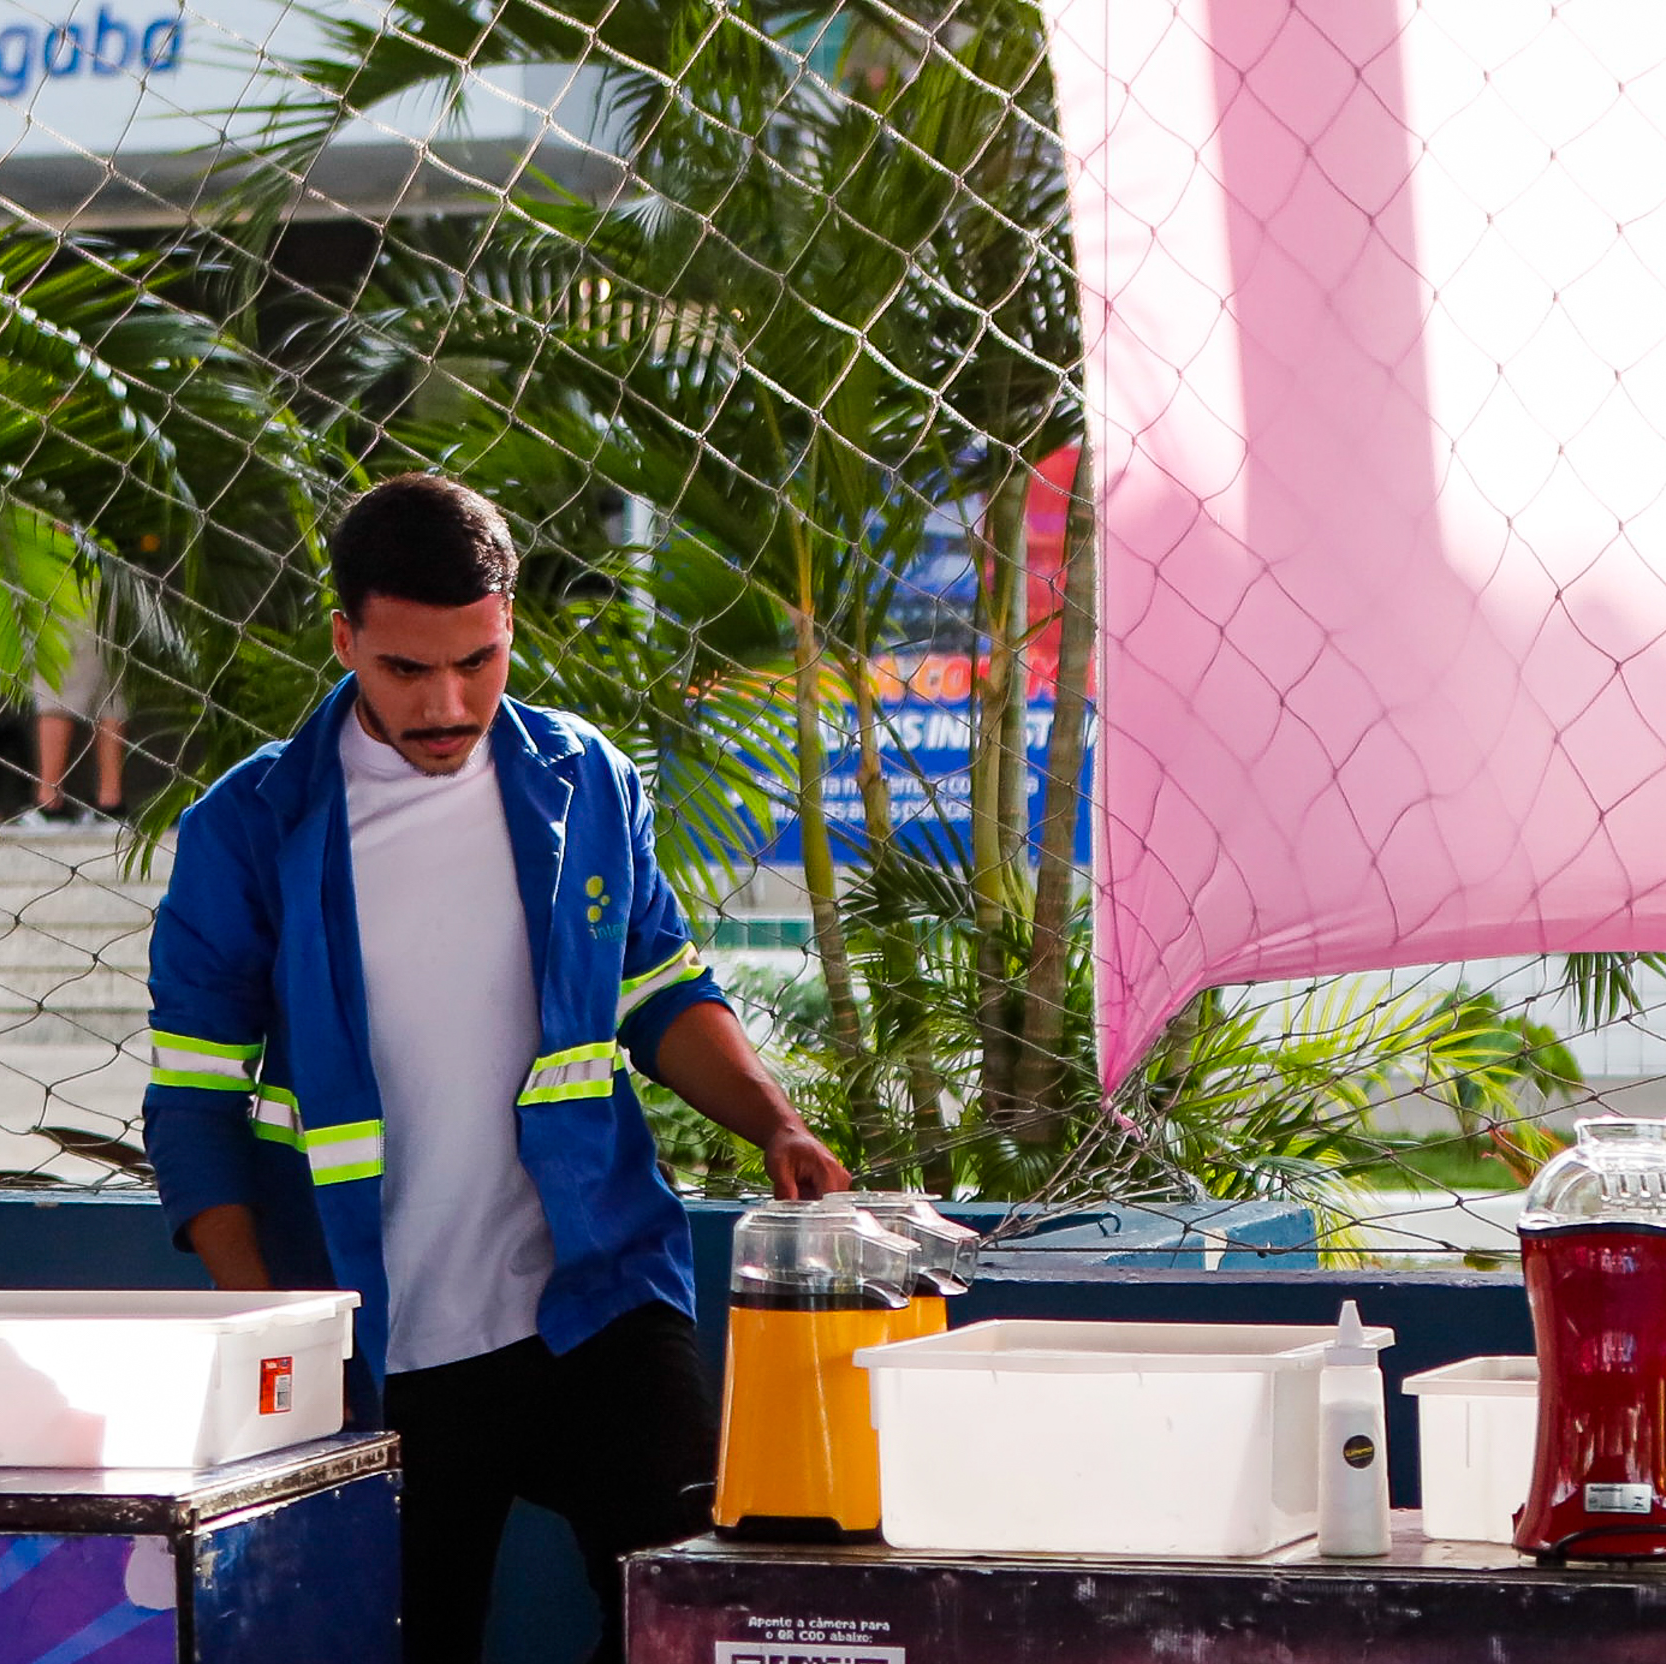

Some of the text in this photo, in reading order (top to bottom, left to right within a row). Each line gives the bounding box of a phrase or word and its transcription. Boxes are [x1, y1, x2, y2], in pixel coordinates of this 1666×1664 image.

[796, 1618, 804, 1627] a
[860, 1621, 890, 1631] para
[765, 1630, 773, 1640] o
[799, 1631, 825, 1641] COD
